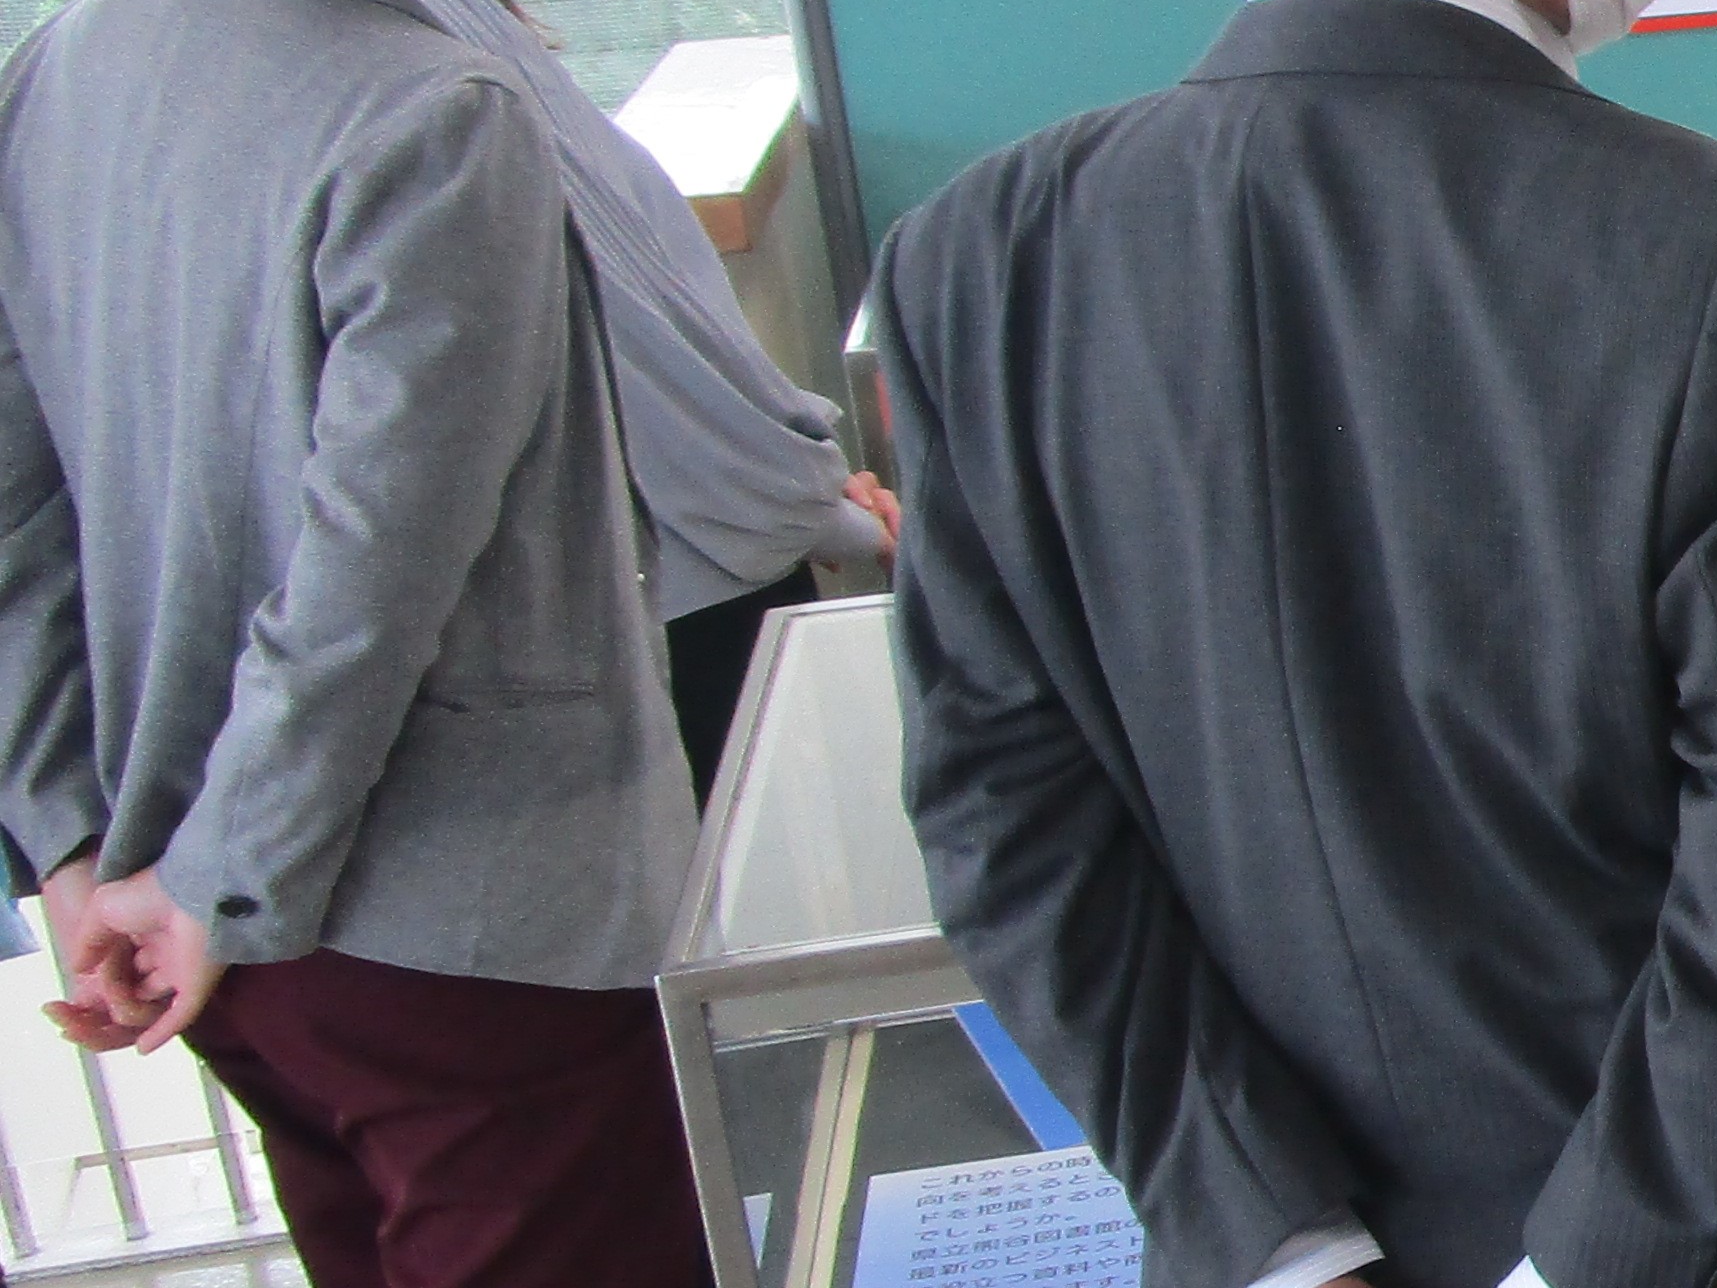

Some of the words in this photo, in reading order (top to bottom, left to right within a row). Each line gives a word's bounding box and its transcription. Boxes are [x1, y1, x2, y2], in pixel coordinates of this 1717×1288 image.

[914, 1212, 1078, 1242] でしょうか。
